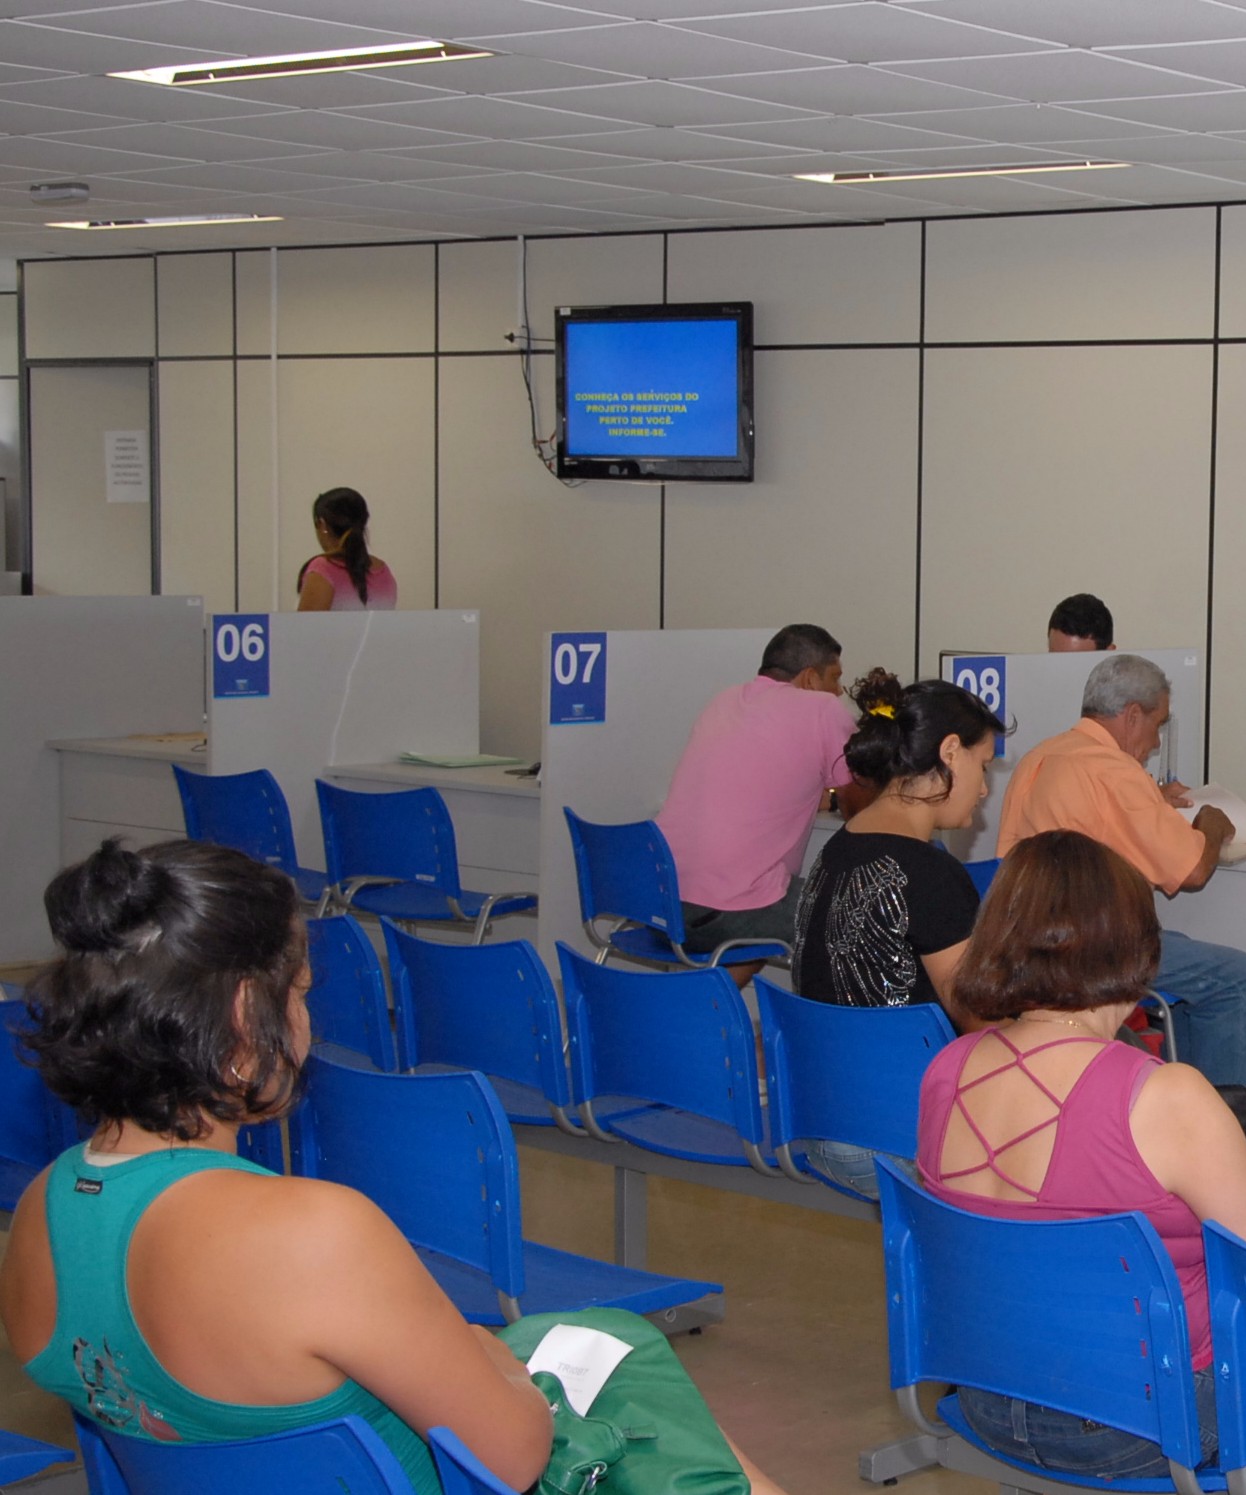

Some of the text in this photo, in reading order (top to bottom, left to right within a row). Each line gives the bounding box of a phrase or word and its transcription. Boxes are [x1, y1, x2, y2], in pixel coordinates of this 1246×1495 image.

[575, 391, 699, 402] CONHEÇA OS SERVIÇOS DO
[586, 404, 687, 413] PROJETO PREFEITURA
[599, 414, 674, 425] PERTO DE VOCÊ.
[609, 428, 667, 437] INFORME-SE.
[217, 623, 265, 662] 06
[554, 643, 601, 685] 07
[956, 667, 1000, 713] 08
